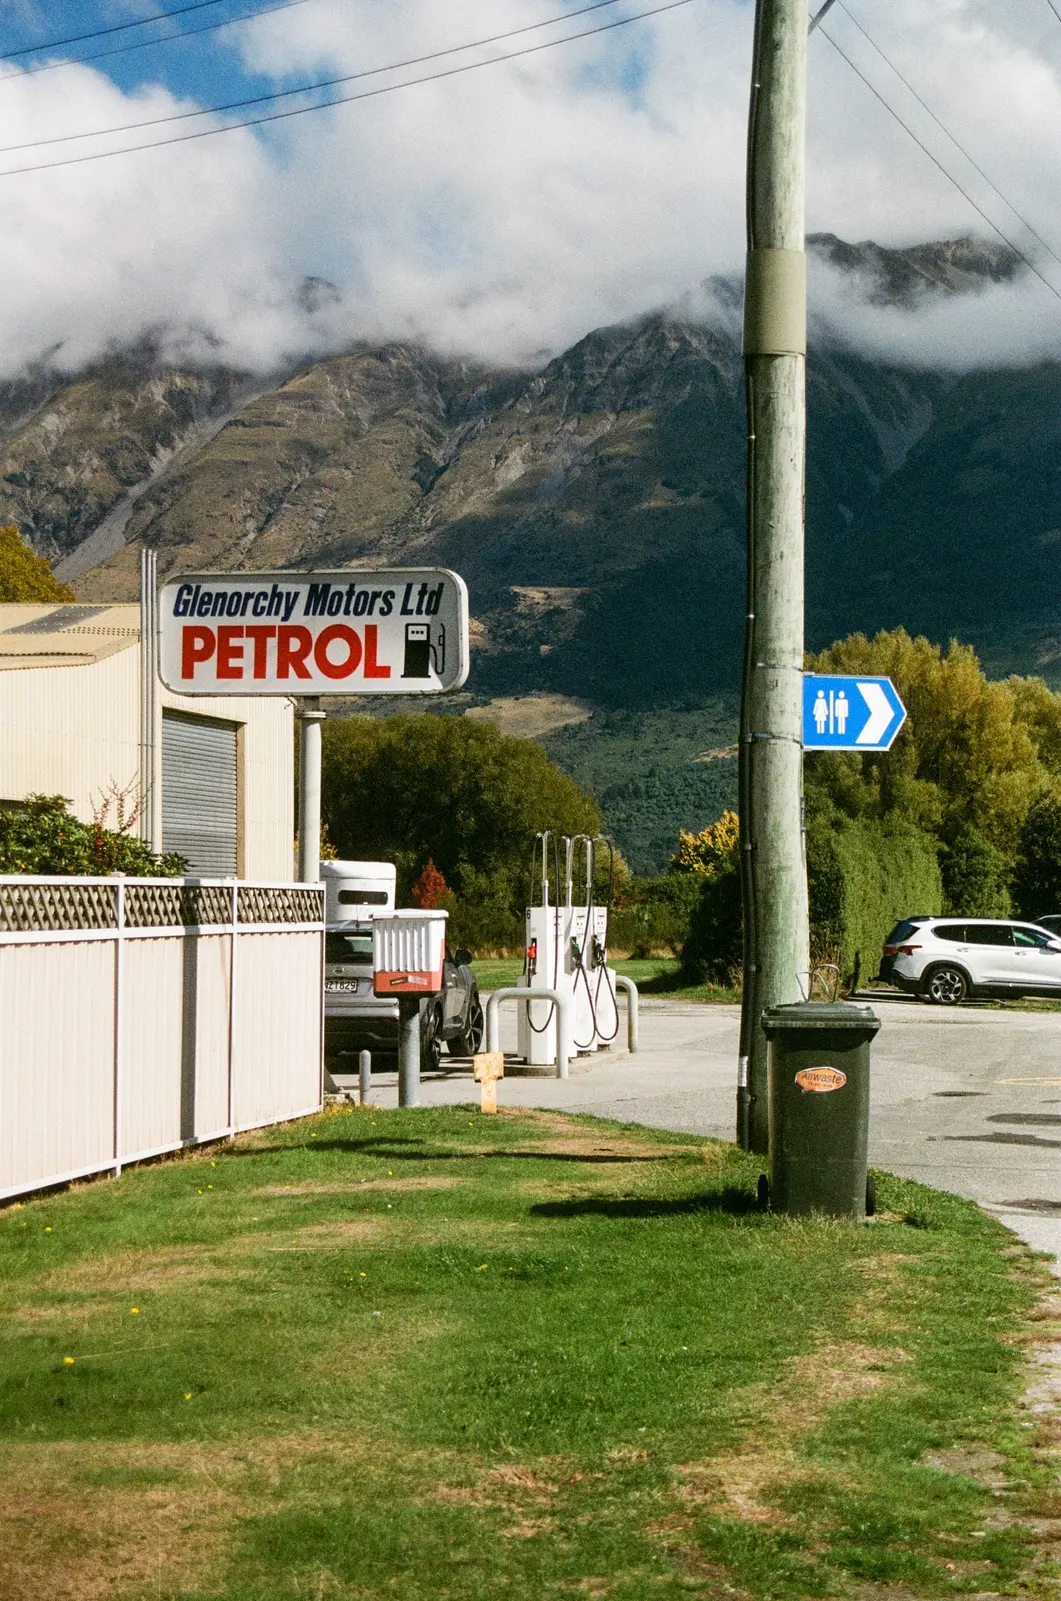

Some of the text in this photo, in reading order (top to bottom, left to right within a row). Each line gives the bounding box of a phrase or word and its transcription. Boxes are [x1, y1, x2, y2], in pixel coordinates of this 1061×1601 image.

[173, 582, 445, 622] Glenorchy Motors Ltd
[181, 624, 391, 679] PETROL
[801, 1072, 842, 1084] Allwaste
